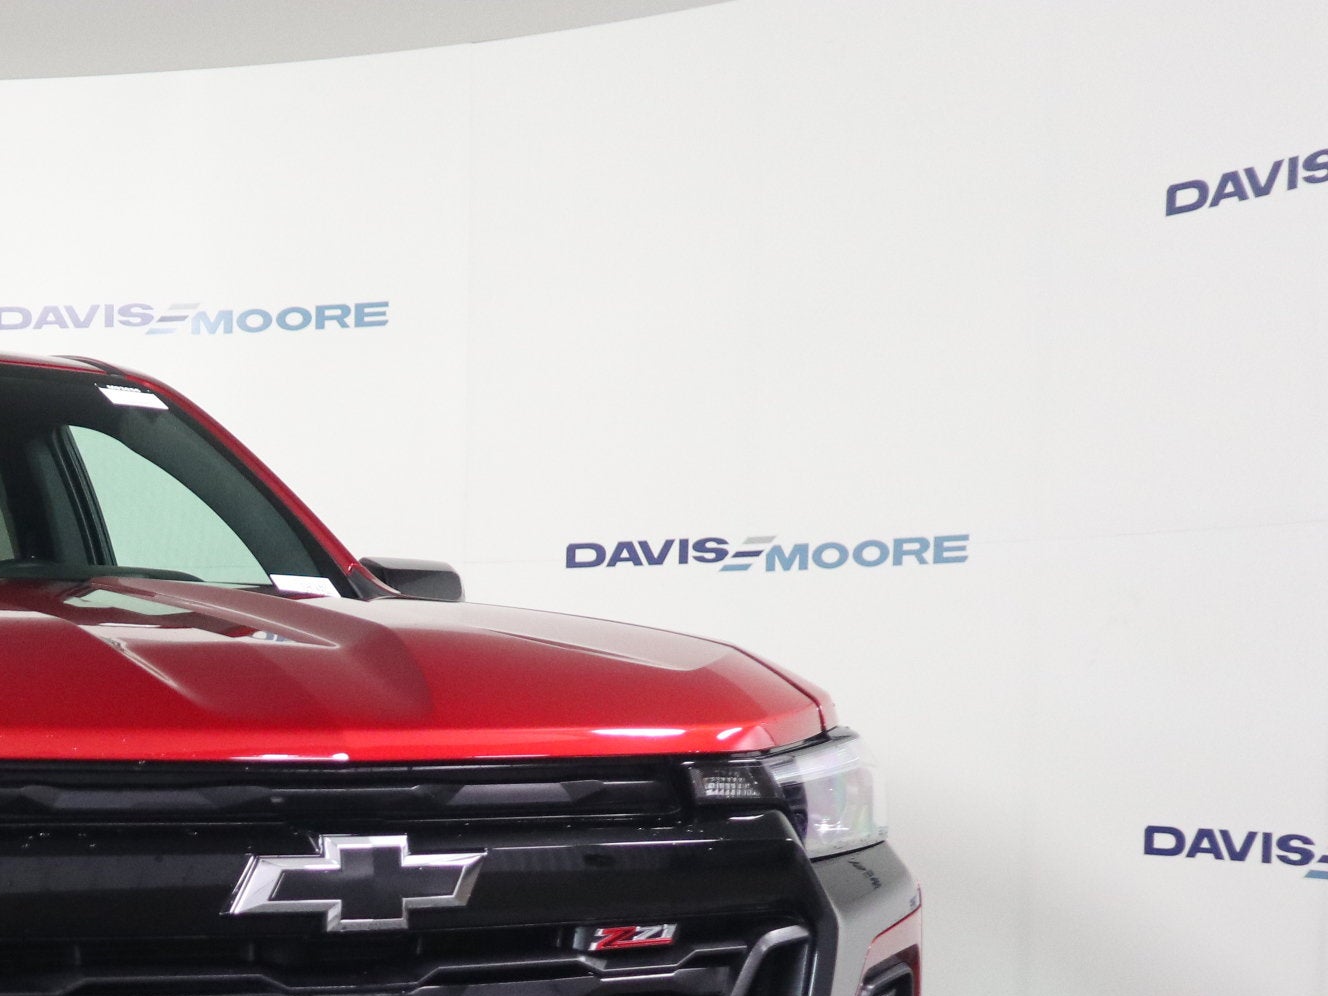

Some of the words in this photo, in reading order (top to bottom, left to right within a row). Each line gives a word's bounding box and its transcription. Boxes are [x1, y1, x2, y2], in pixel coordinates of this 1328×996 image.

[1164, 147, 1328, 217] DAVIS
[191, 300, 390, 336] MOORE
[564, 536, 730, 570] DAVIS
[764, 533, 970, 573] MOORE
[1142, 824, 1316, 867] DAVIS
[588, 923, 677, 951] Z71
